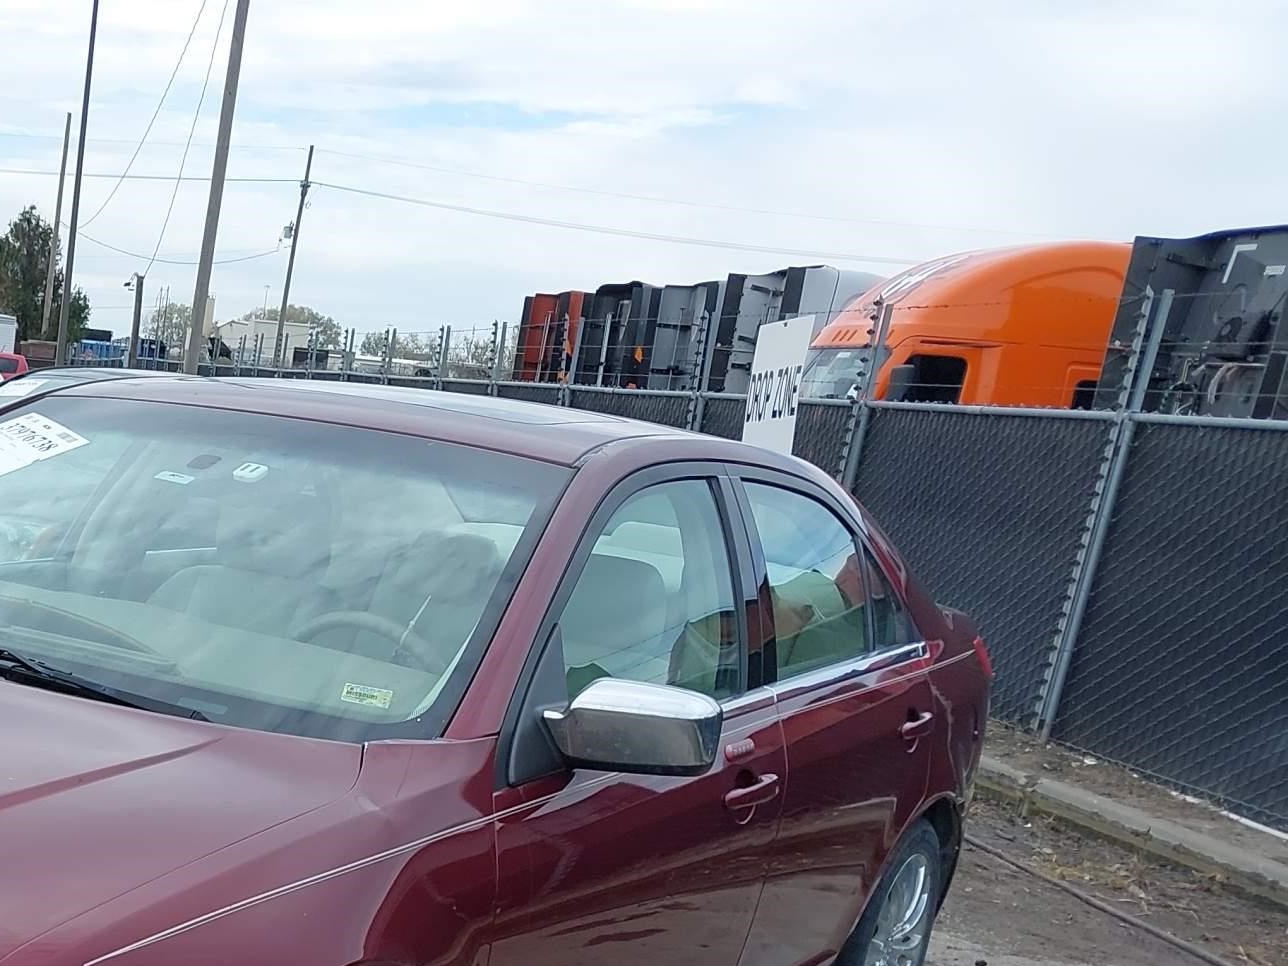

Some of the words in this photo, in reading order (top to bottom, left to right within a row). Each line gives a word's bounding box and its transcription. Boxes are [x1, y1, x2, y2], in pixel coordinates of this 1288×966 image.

[746, 370, 774, 422] DROP
[772, 365, 802, 418] ZONE
[0, 422, 59, 452] 37976738
